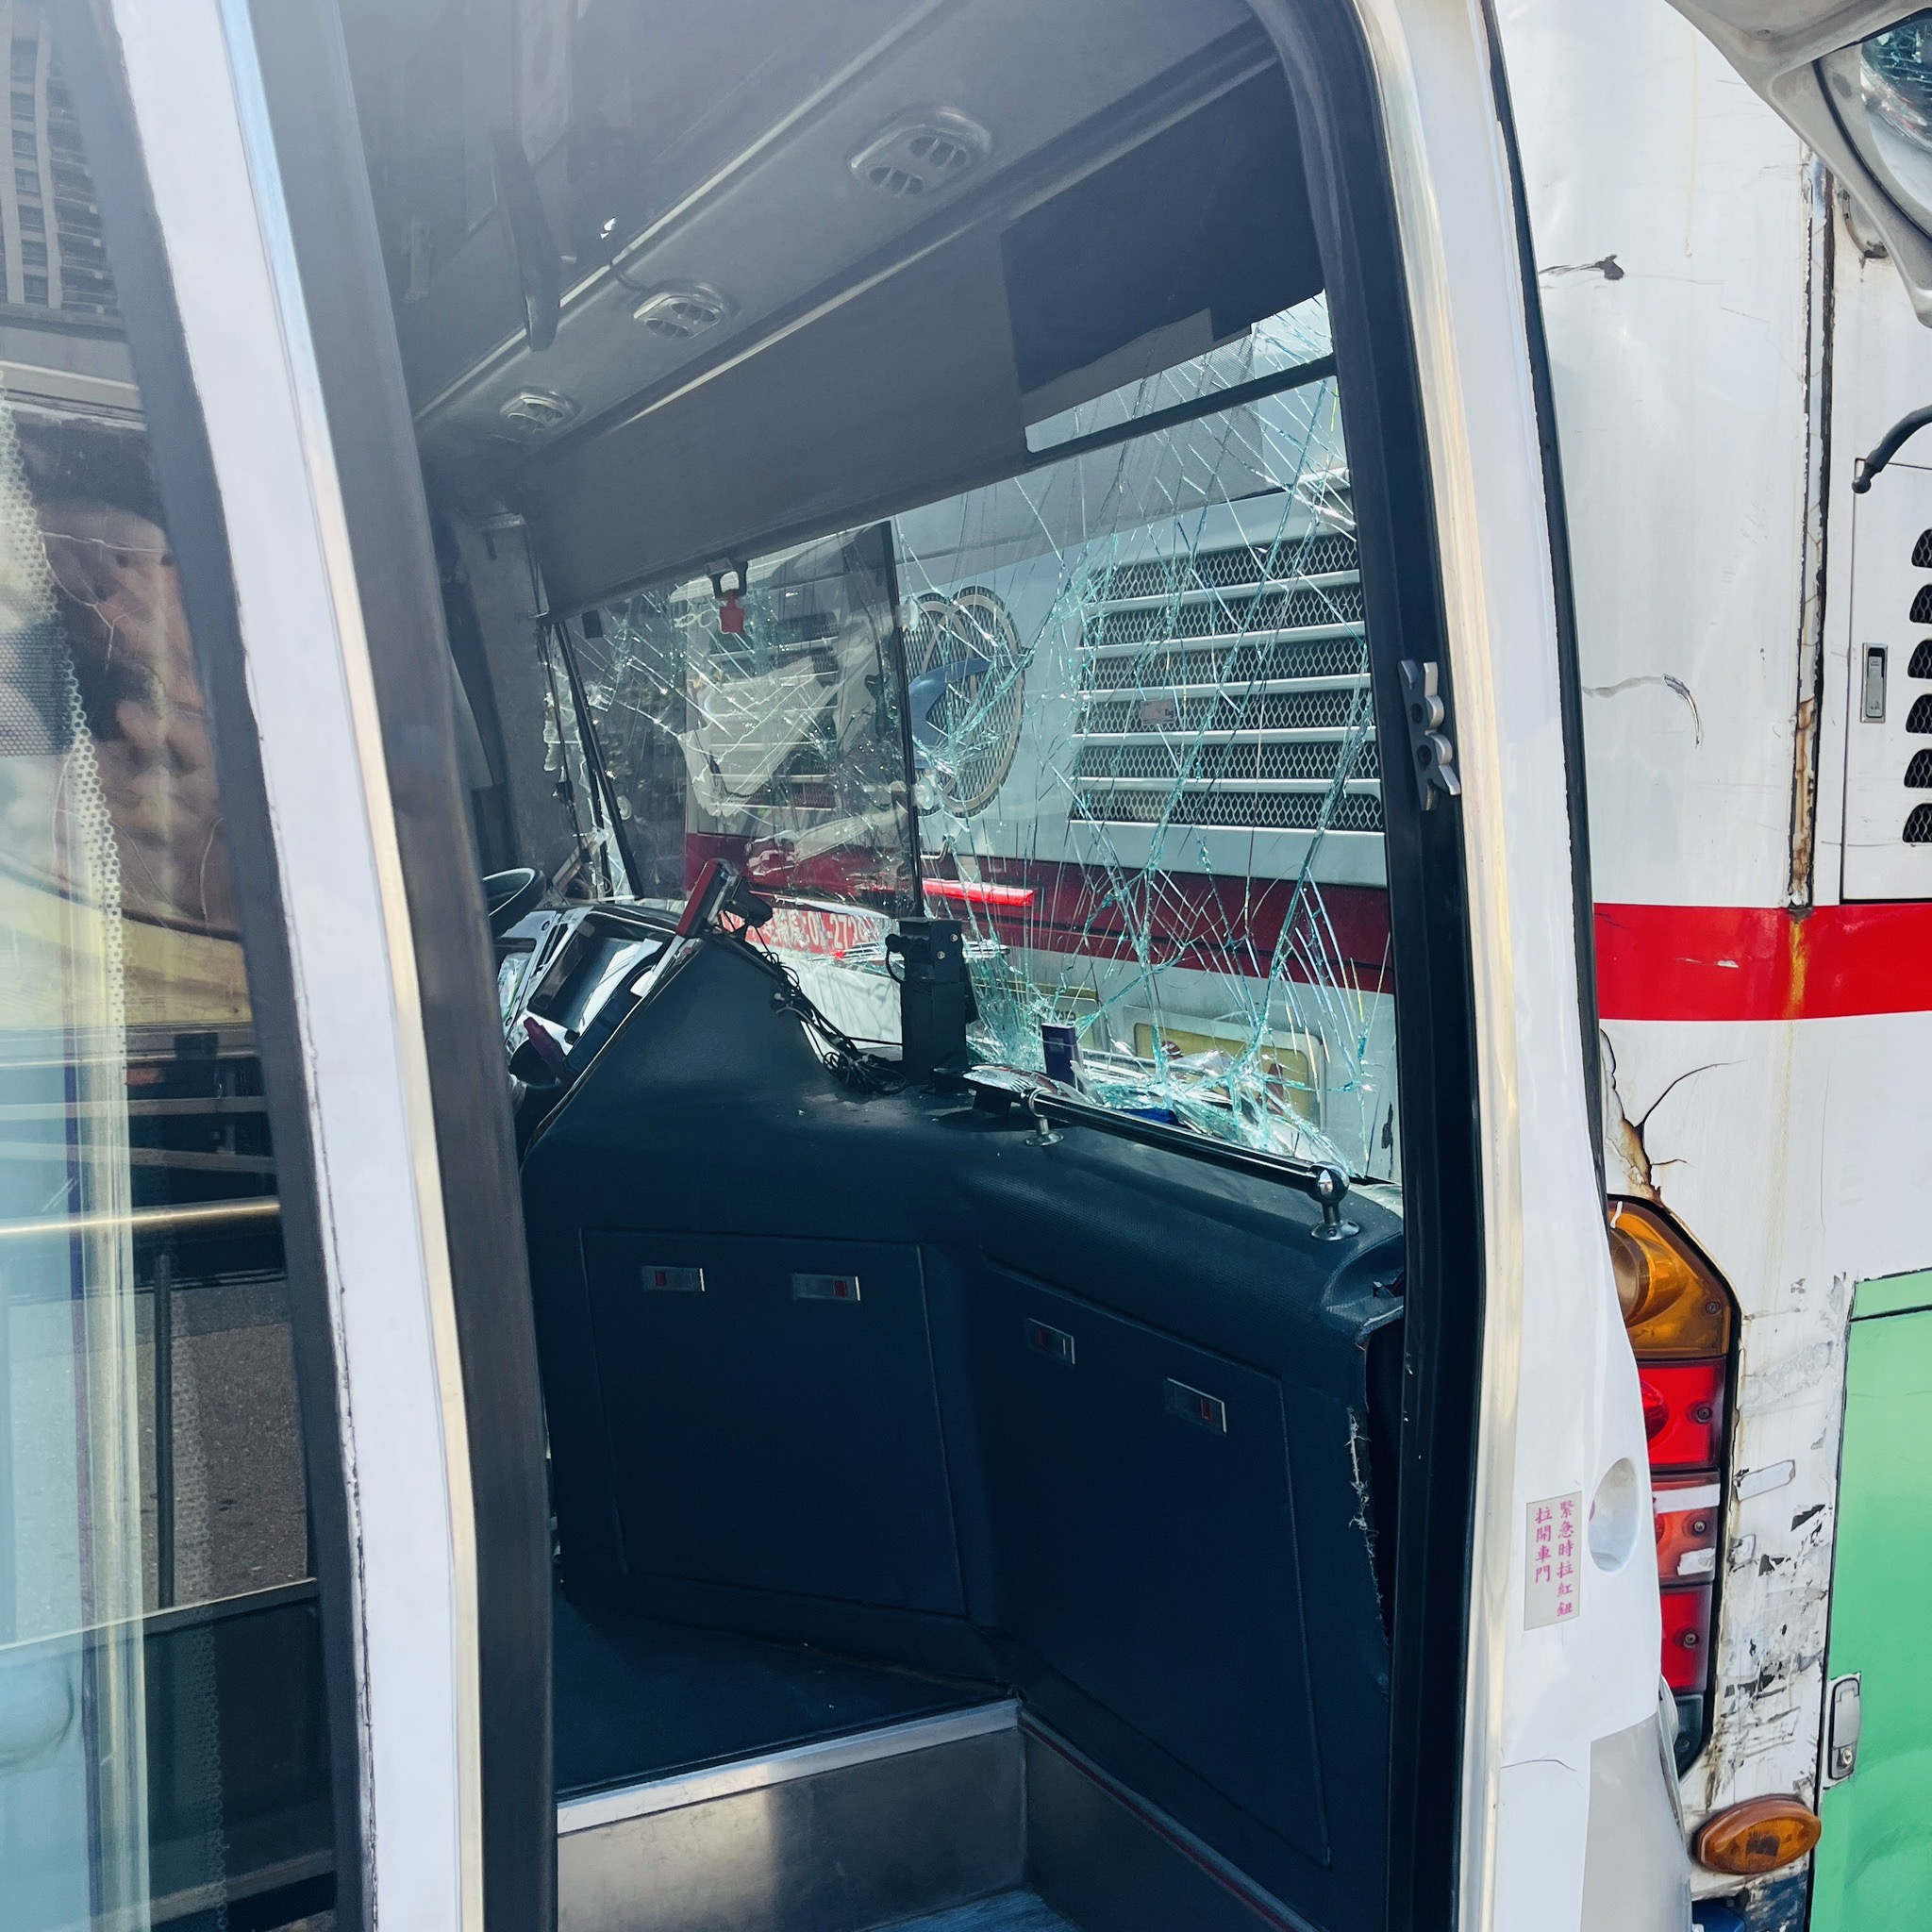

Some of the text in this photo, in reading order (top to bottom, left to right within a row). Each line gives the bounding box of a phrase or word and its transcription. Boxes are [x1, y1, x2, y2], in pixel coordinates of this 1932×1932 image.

[1535, 1507, 1553, 1583] 拉開車門
[1557, 1500, 1574, 1617] 緊急時拉紅鈕
